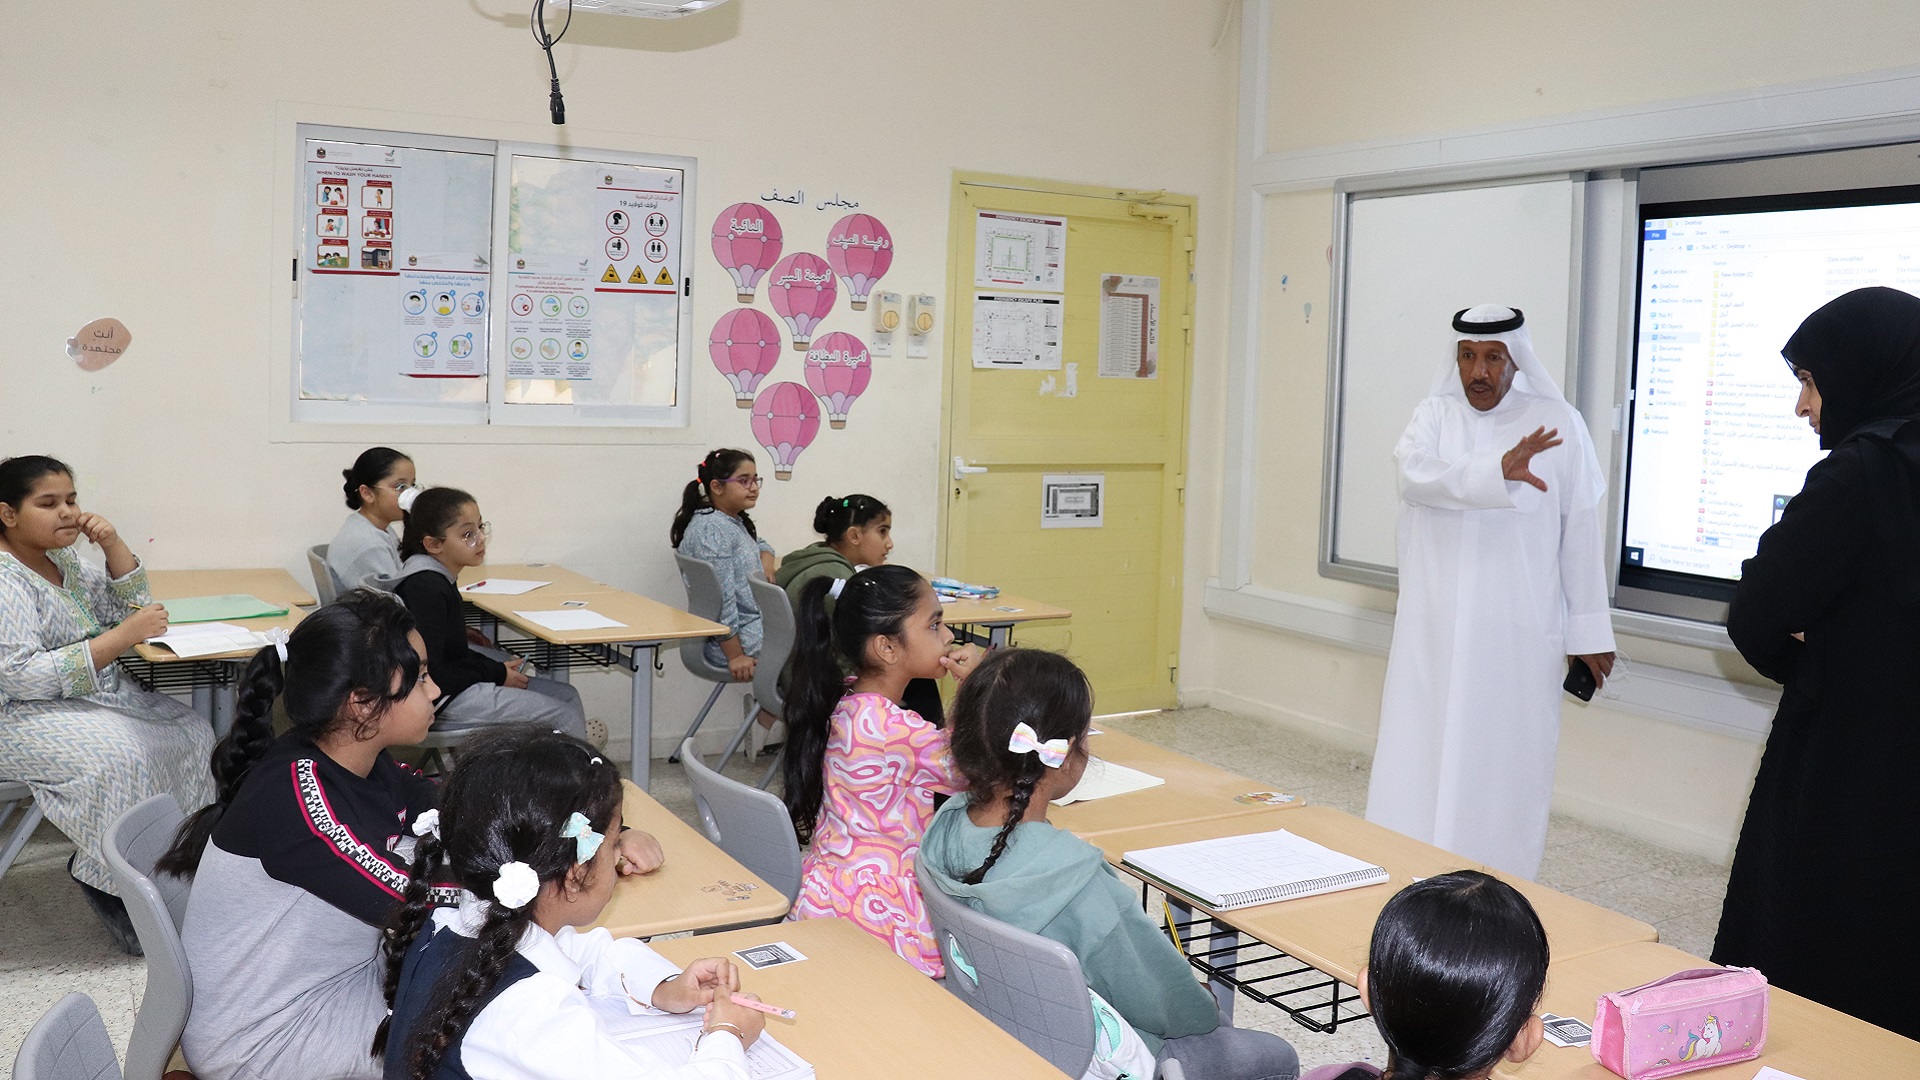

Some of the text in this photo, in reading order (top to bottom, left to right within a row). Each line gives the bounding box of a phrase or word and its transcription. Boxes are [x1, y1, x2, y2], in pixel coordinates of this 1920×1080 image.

[760, 188, 859, 211] مجلس الصف
[730, 218, 764, 234] النائبة
[832, 234, 860, 245] الصف
[805, 269, 832, 283] أمينة
[94, 326, 114, 339] أنت
[82, 344, 121, 356] مجتهدة
[808, 350, 868, 366] أميرة النظافة
[1660, 556, 1672, 564] Type
[304, 794, 333, 832] SHINE
[354, 848, 392, 882] SHINE
